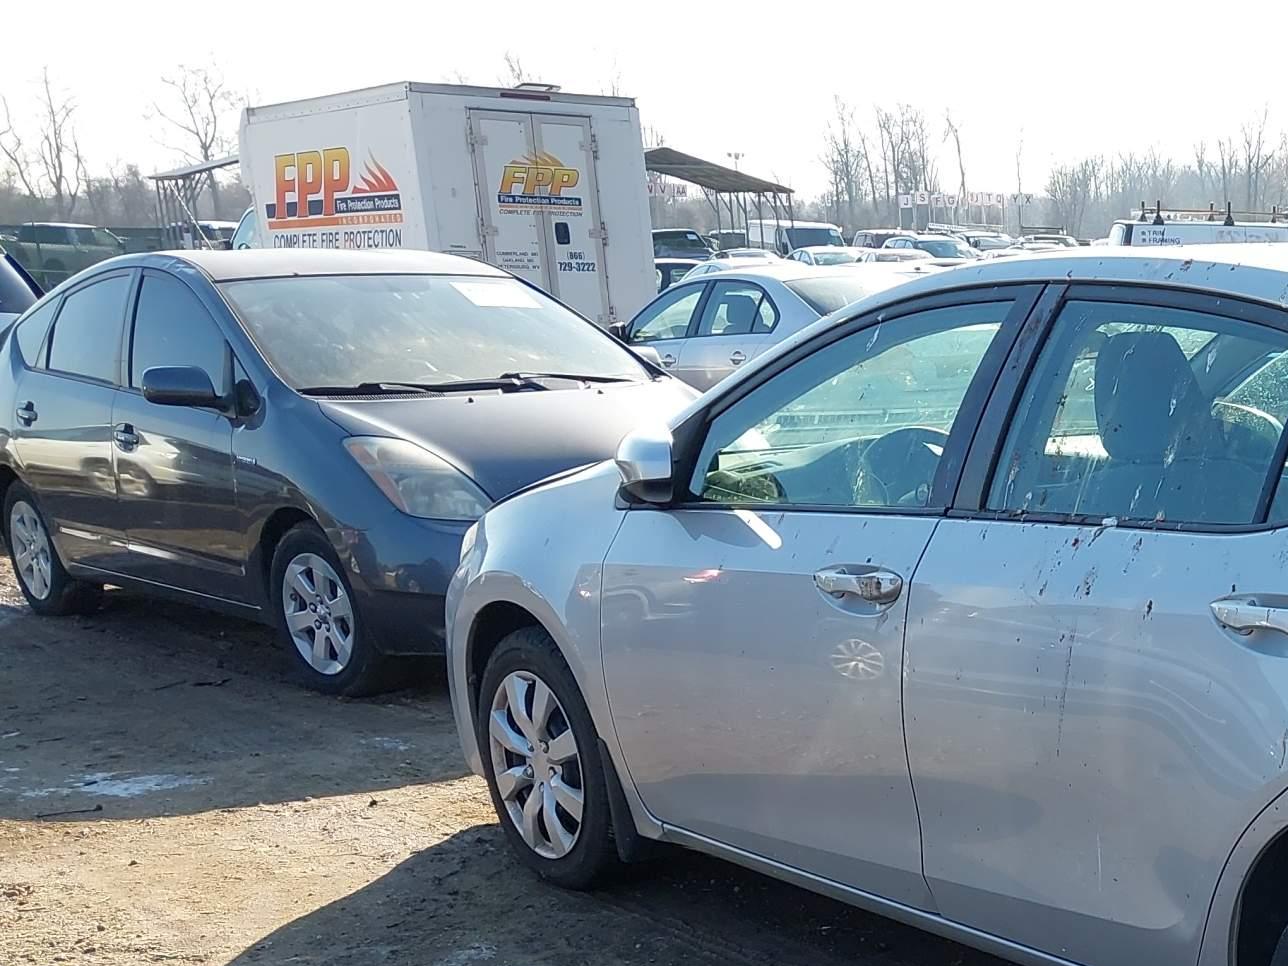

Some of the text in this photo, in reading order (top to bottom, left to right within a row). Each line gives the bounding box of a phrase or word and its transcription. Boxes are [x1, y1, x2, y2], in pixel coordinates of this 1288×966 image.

[274, 147, 350, 220] FPP
[498, 165, 579, 196] FPP
[336, 197, 399, 211] Fire Protection Products
[515, 196, 549, 204] Protection
[550, 197, 579, 206] Products
[1024, 195, 1032, 204] X
[338, 214, 402, 225] INCORPORATED
[273, 228, 402, 249] COMPLETE FIRE PROTECTION
[566, 251, 586, 261] (866)
[558, 261, 597, 272] 729-3222
